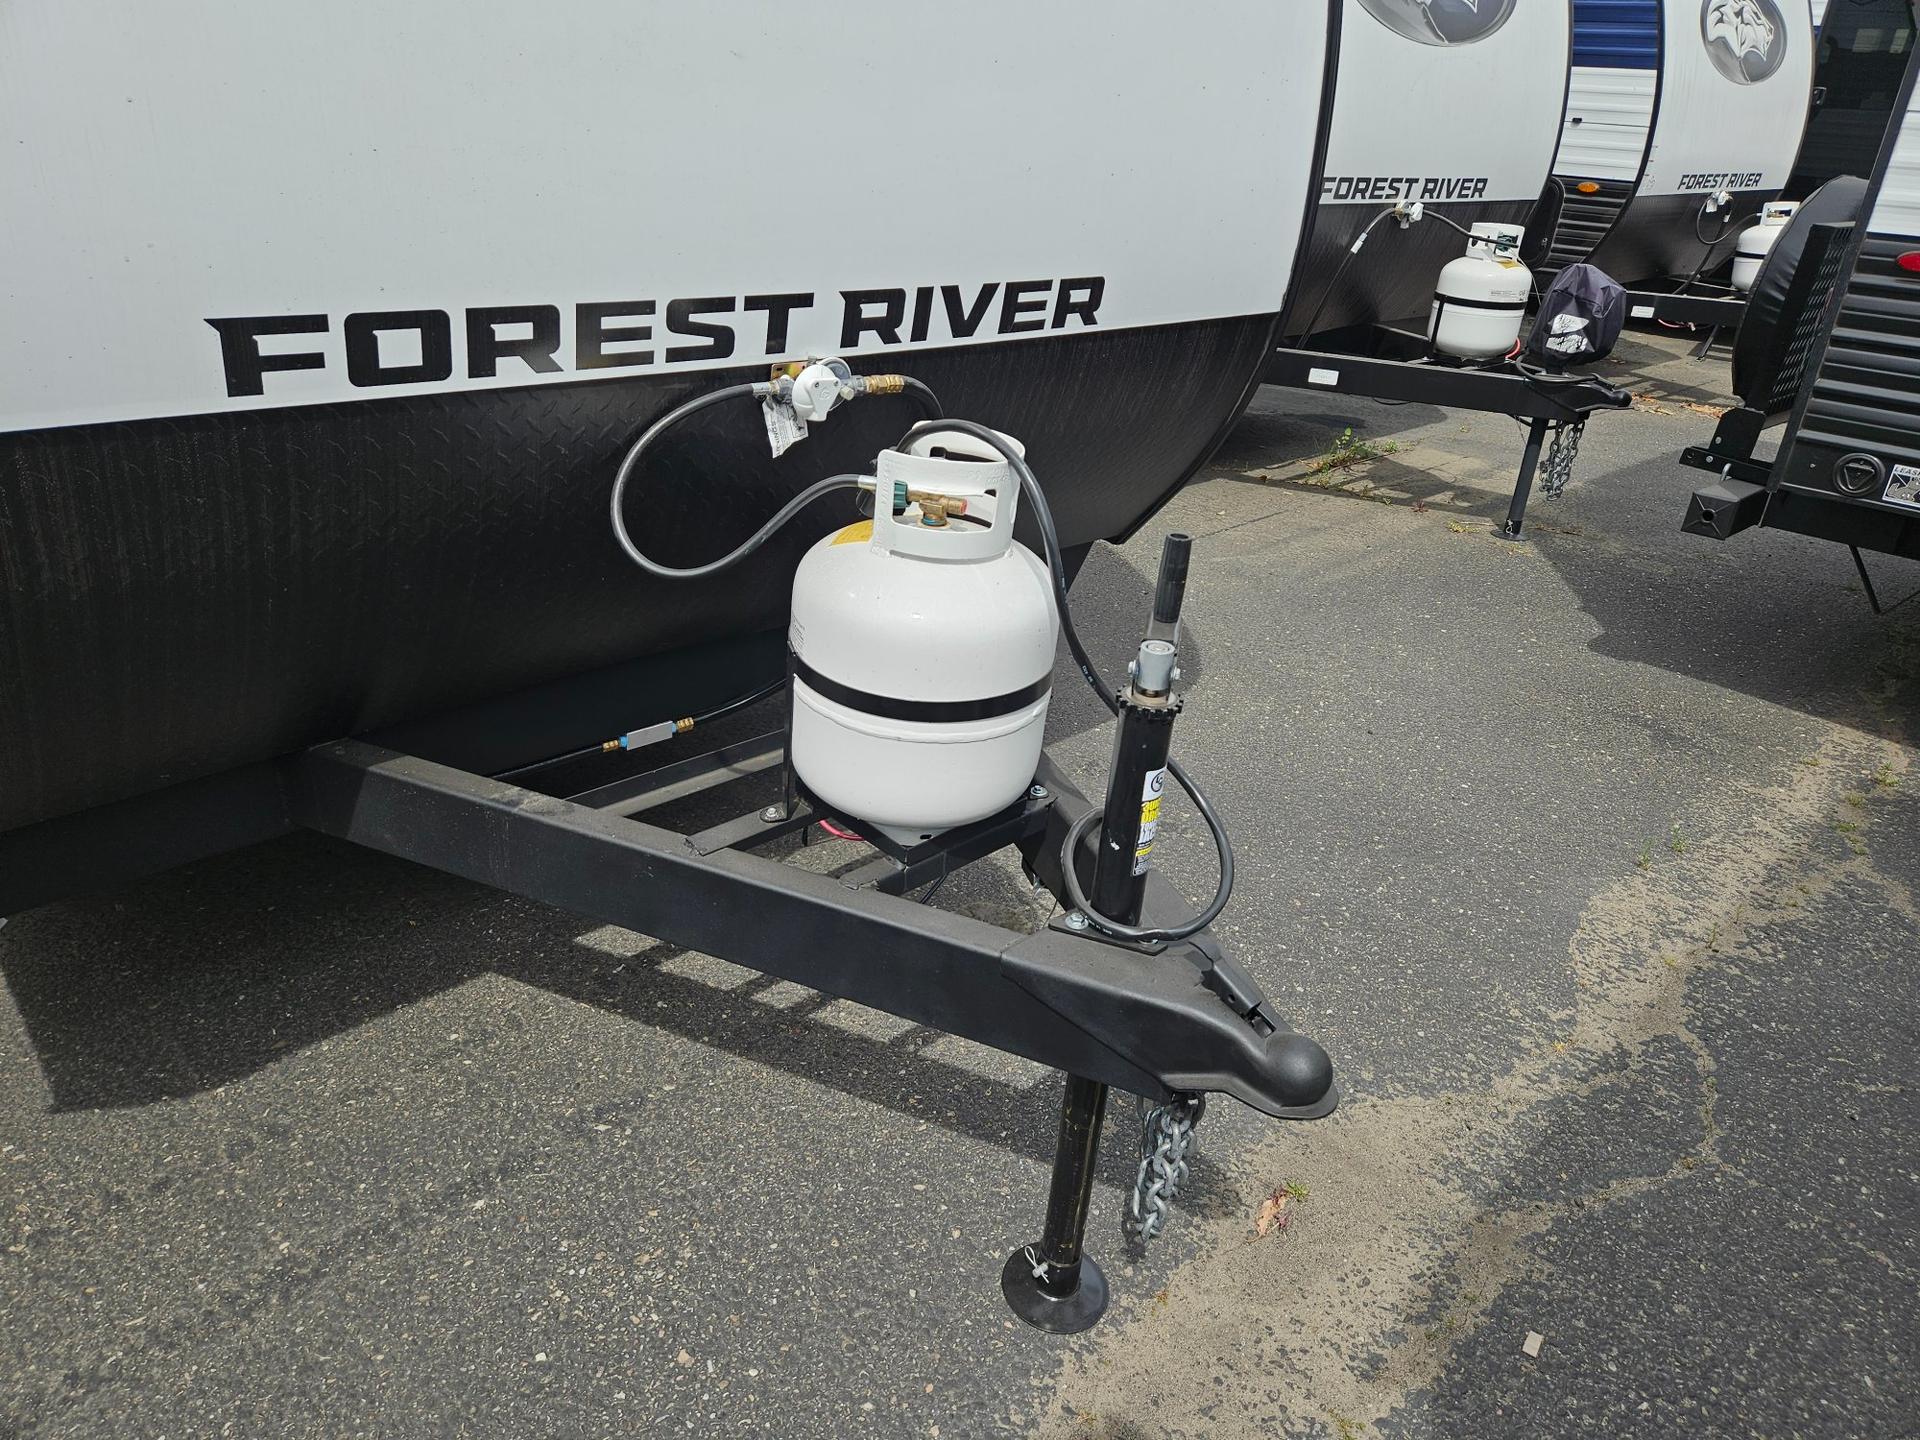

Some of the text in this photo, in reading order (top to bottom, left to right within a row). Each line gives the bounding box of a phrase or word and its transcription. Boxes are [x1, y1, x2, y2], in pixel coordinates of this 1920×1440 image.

[1321, 177, 1488, 200] FOREST RIVER
[1677, 173, 1762, 190] FOREST RIVER
[203, 276, 1104, 397] FOREST RIVER
